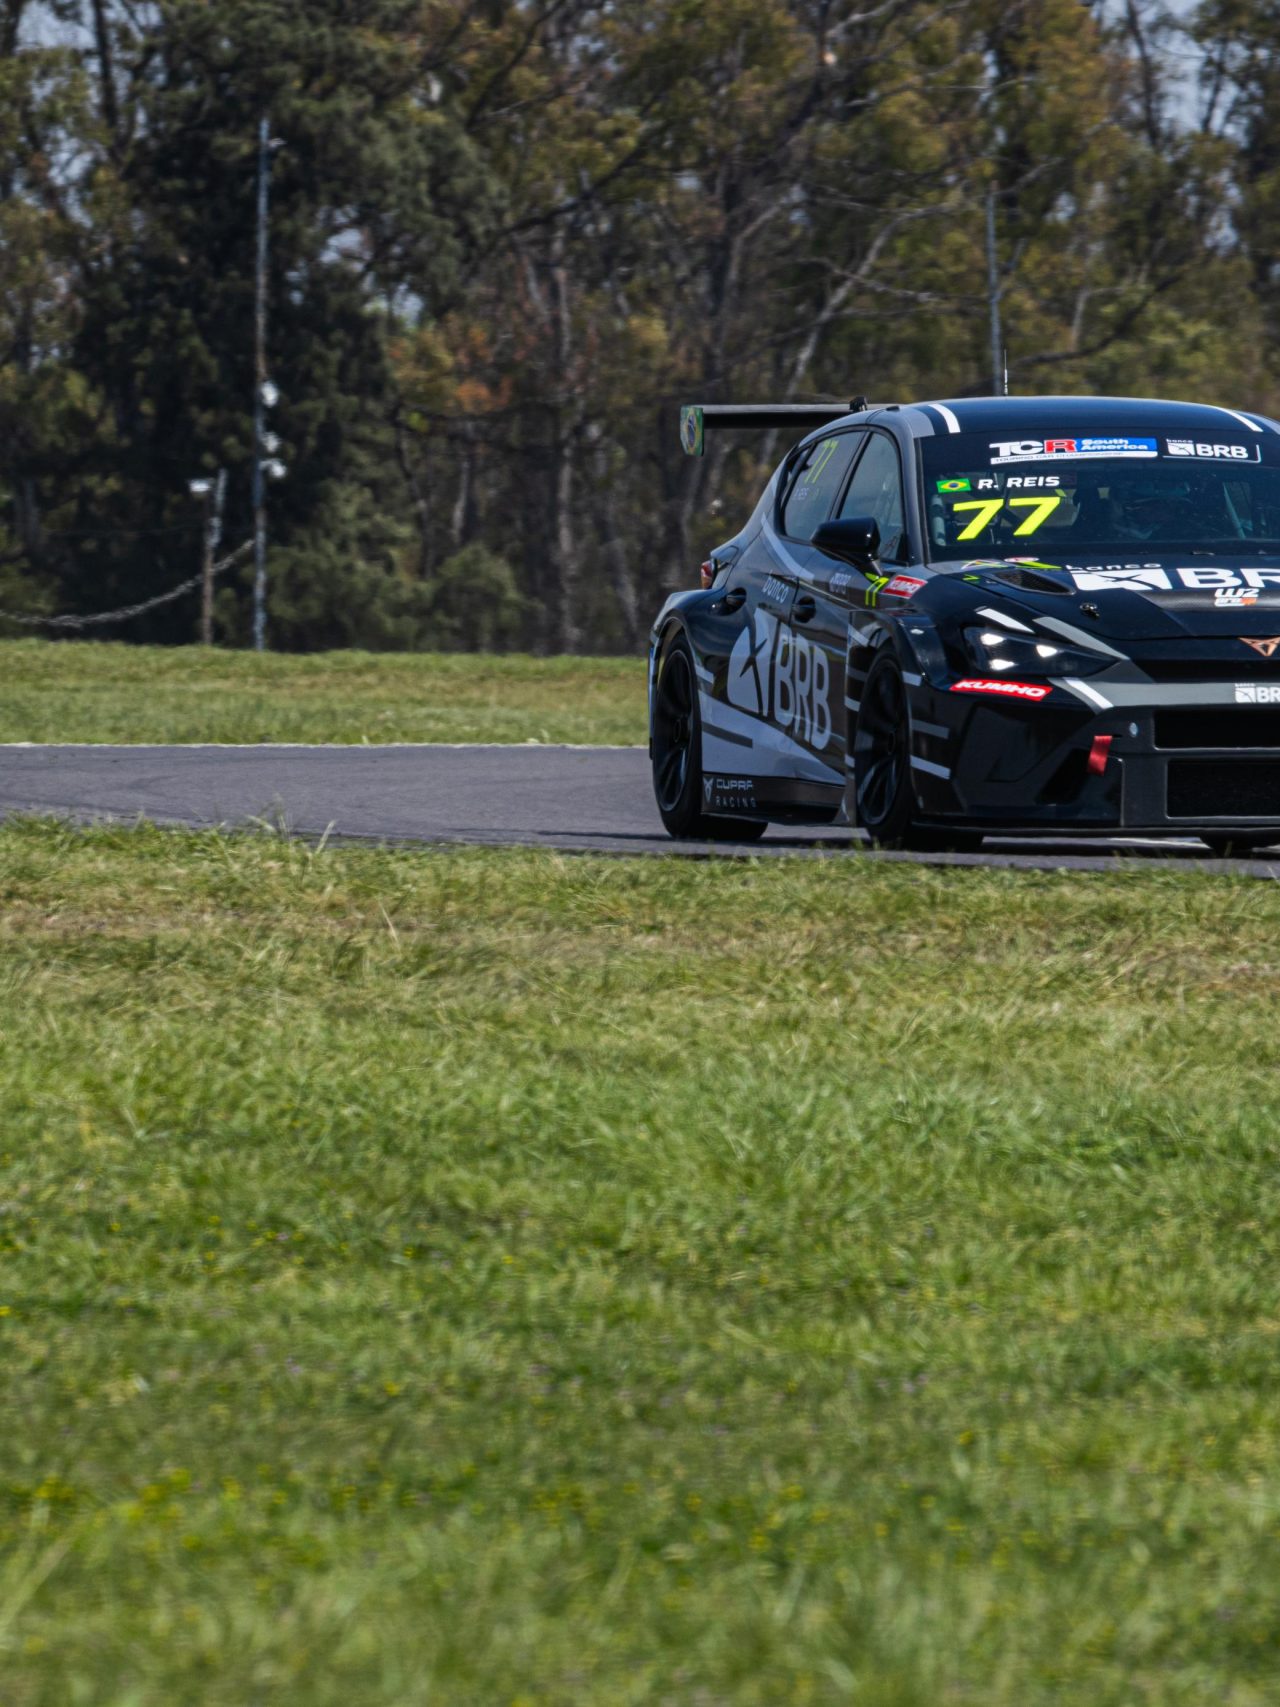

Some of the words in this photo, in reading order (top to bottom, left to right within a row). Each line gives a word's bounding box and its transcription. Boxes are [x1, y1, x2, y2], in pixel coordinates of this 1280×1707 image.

[989, 439, 1077, 457] TCR
[1196, 443, 1248, 459] BRB
[804, 439, 839, 484] 77
[977, 479, 998, 489] R.
[1006, 476, 1060, 488] REIS
[953, 496, 1061, 541] 77
[1065, 563, 1161, 571] banco
[762, 569, 791, 603] banco
[774, 622, 832, 750] BRB
[954, 680, 1046, 697] KUMHO
[716, 796, 757, 808] RACING
